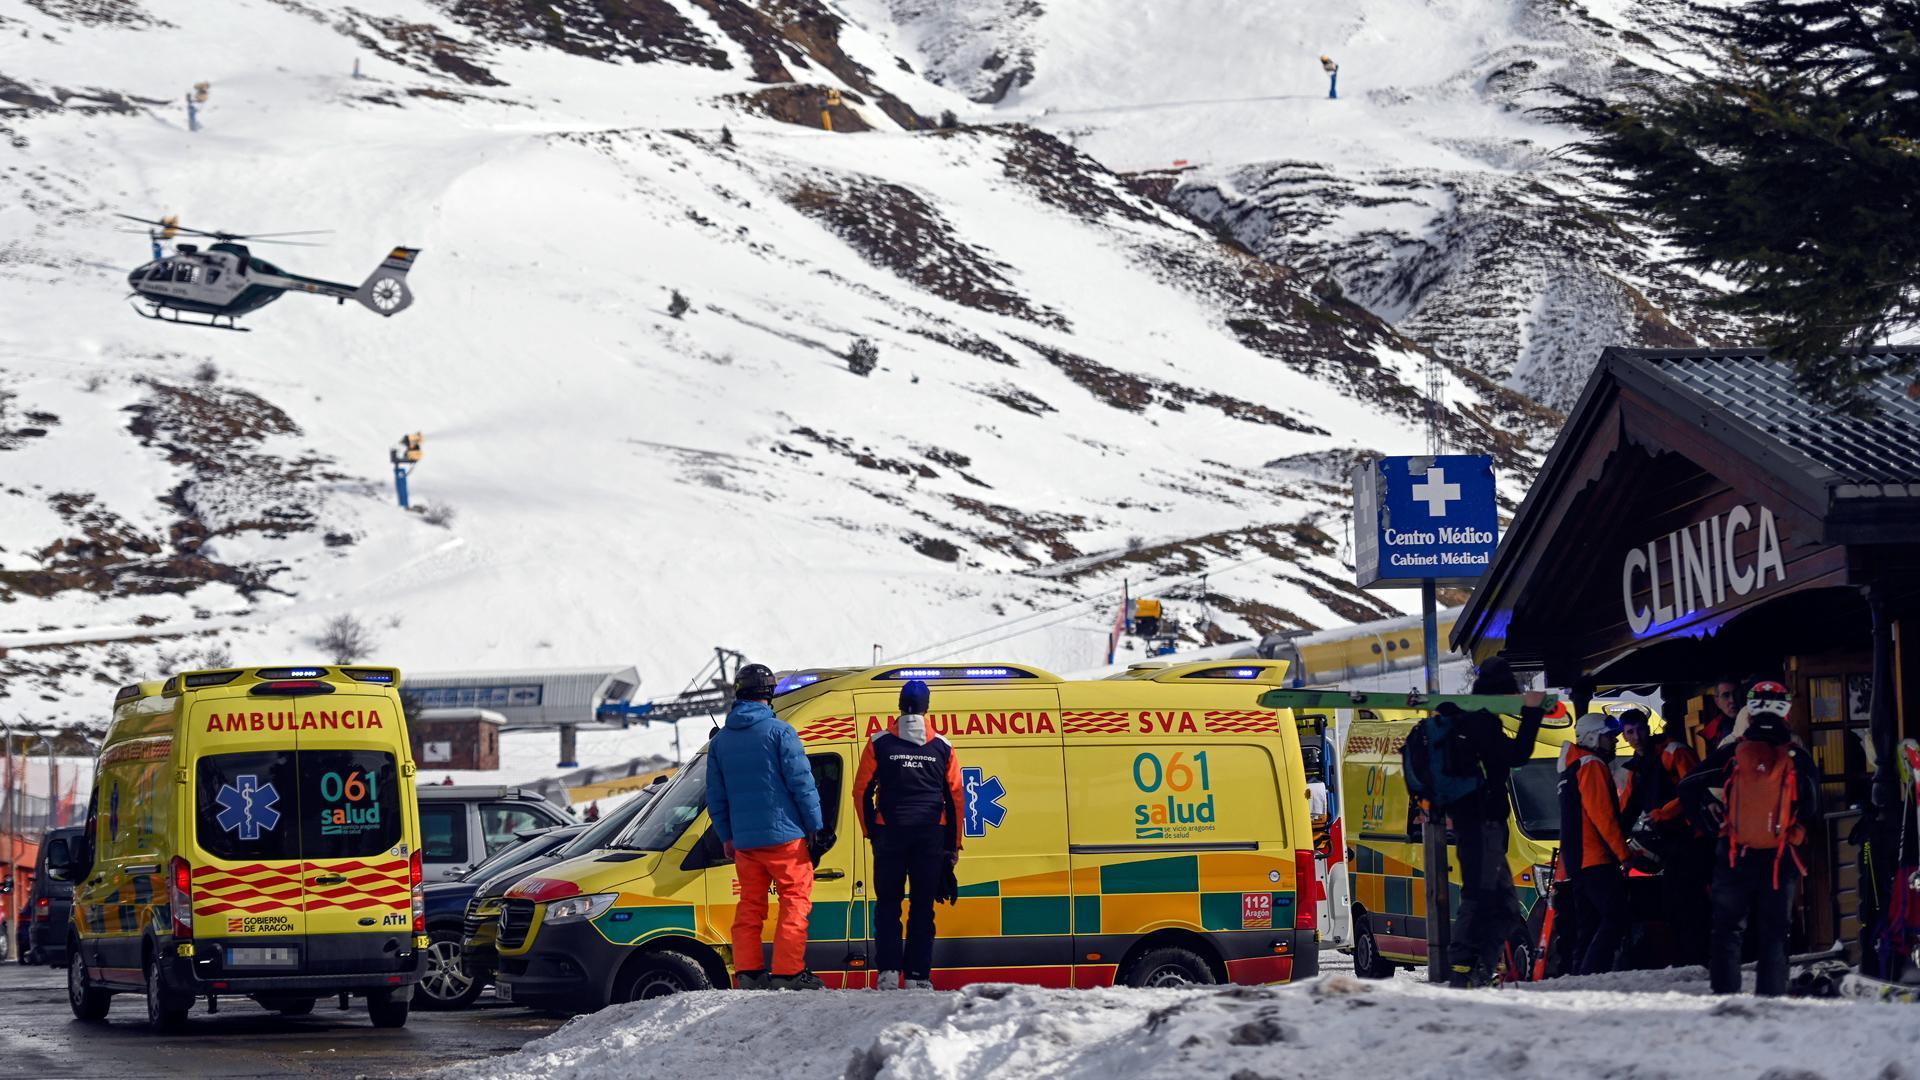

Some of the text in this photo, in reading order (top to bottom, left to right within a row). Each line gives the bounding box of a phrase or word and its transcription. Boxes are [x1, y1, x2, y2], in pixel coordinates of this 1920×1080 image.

[1384, 528, 1435, 545] Centro
[1438, 527, 1493, 544] Médico
[1390, 551, 1489, 566] Cabinet Médical
[1623, 505, 1786, 634] CLINICA
[206, 710, 383, 732] AMBULANCIA
[865, 711, 1198, 737] AULANCIA SVA
[1133, 751, 1210, 793] 061
[1366, 766, 1389, 796] 061
[320, 771, 377, 802] 061
[321, 802, 380, 825] salud
[1135, 793, 1215, 825] salud
[1245, 896, 1269, 909] 112
[1245, 908, 1270, 919] Aragón
[244, 916, 288, 925] GOBIERNO
[244, 925, 255, 933] DE
[382, 914, 407, 926] ATH
